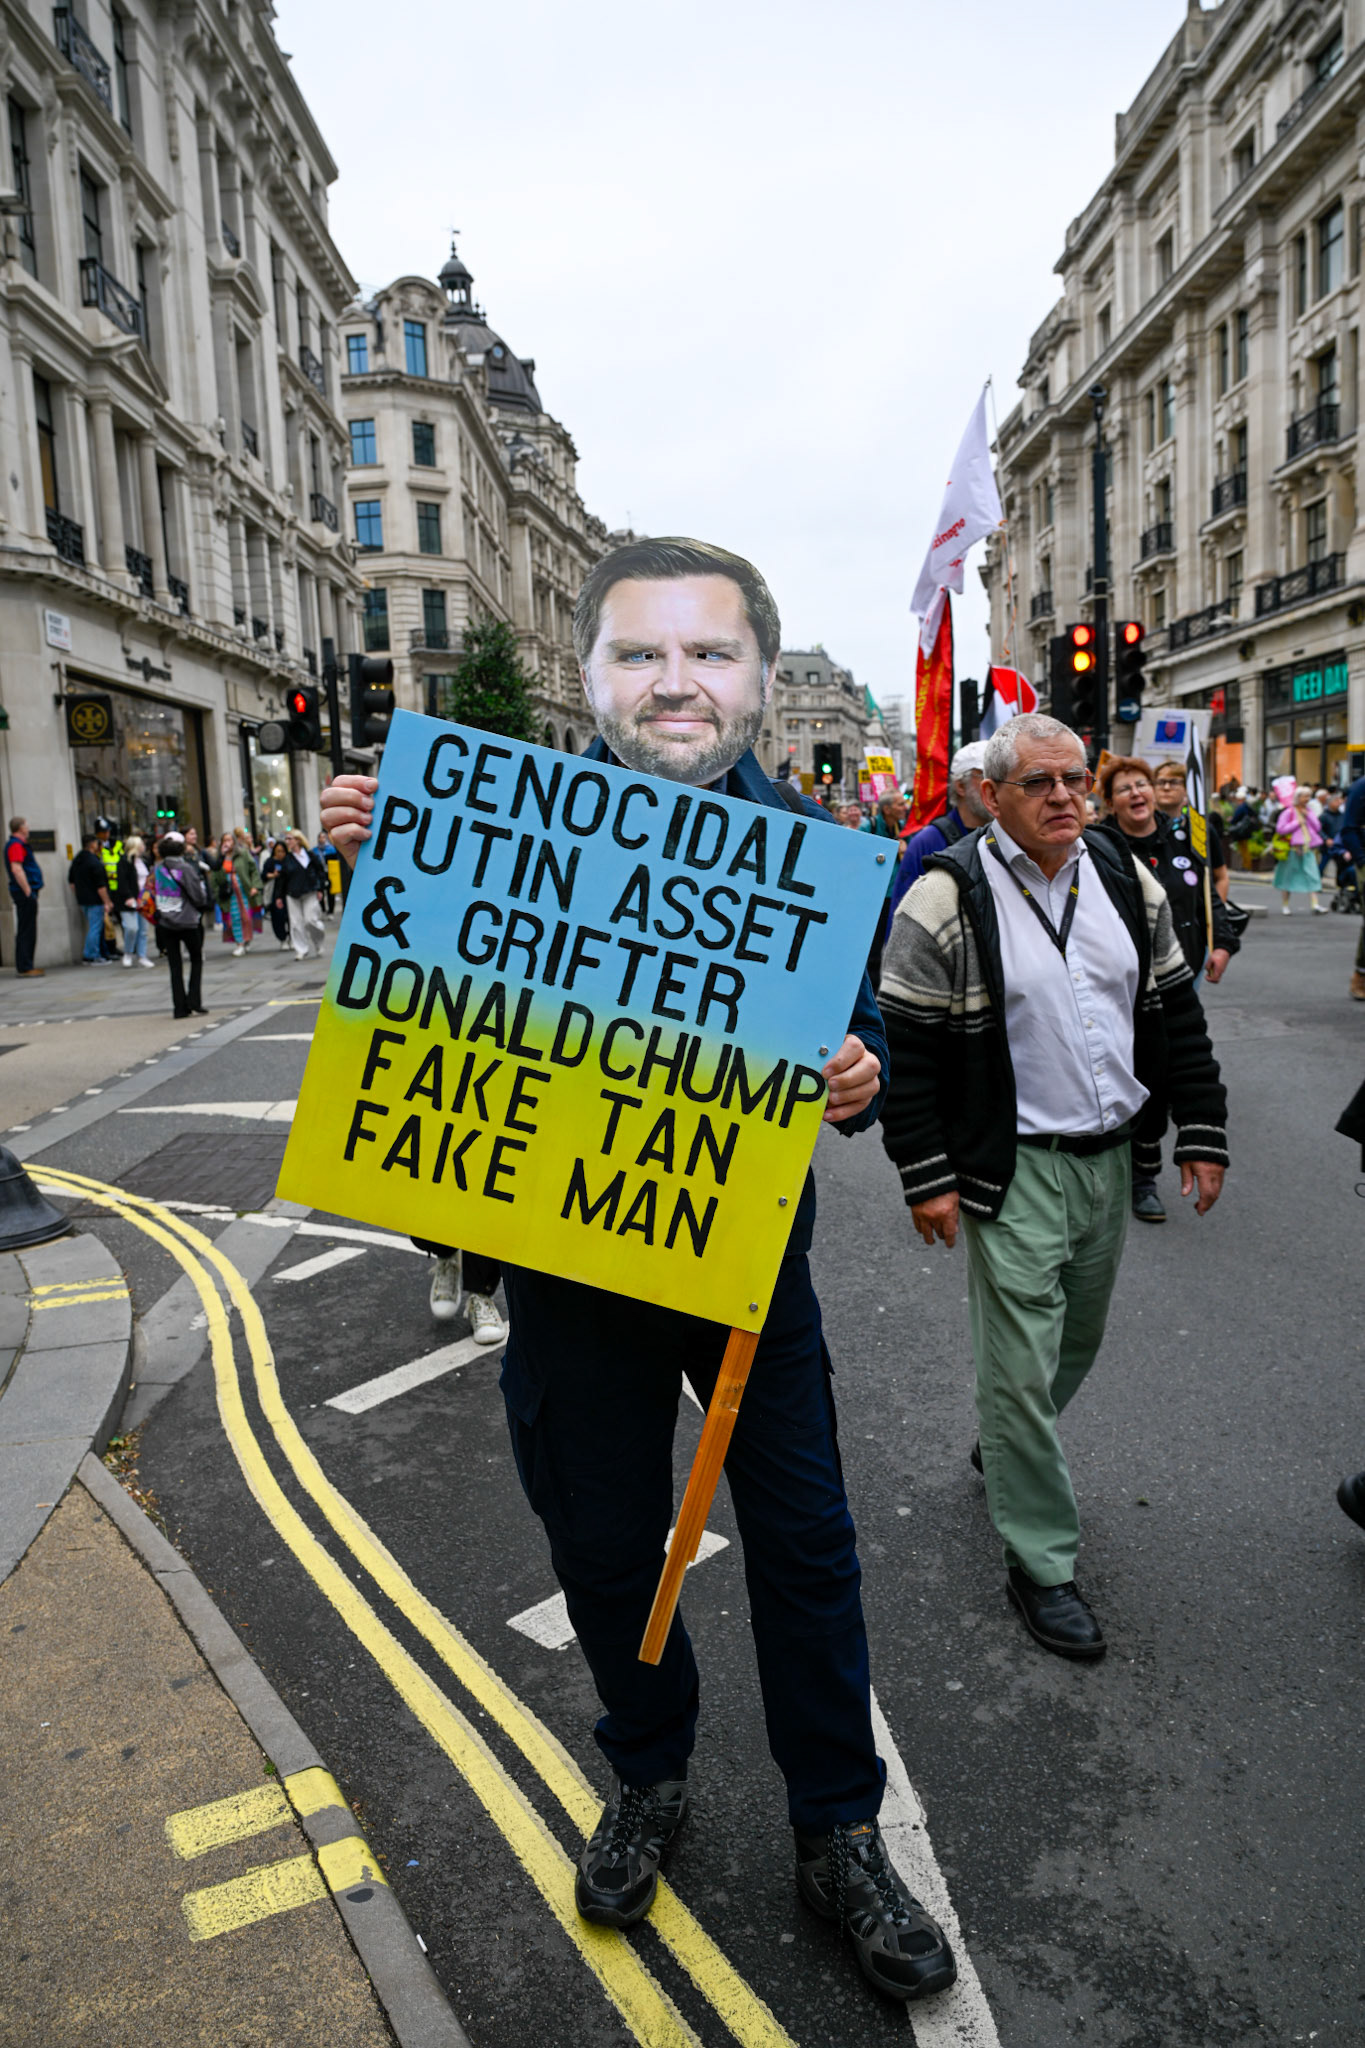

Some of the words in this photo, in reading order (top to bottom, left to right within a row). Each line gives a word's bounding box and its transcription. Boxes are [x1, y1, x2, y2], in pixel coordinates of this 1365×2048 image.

[372, 795, 582, 913] PUTIN
[610, 863, 829, 973] ASSET
[423, 733, 815, 898] GENOCIDAL
[362, 876, 411, 950] &
[458, 900, 746, 1034] GRIFTER
[344, 1099, 528, 1204] FAKE
[561, 1157, 719, 1259] MAN
[361, 1028, 552, 1135] FAKE
[600, 1088, 741, 1187] TAN
